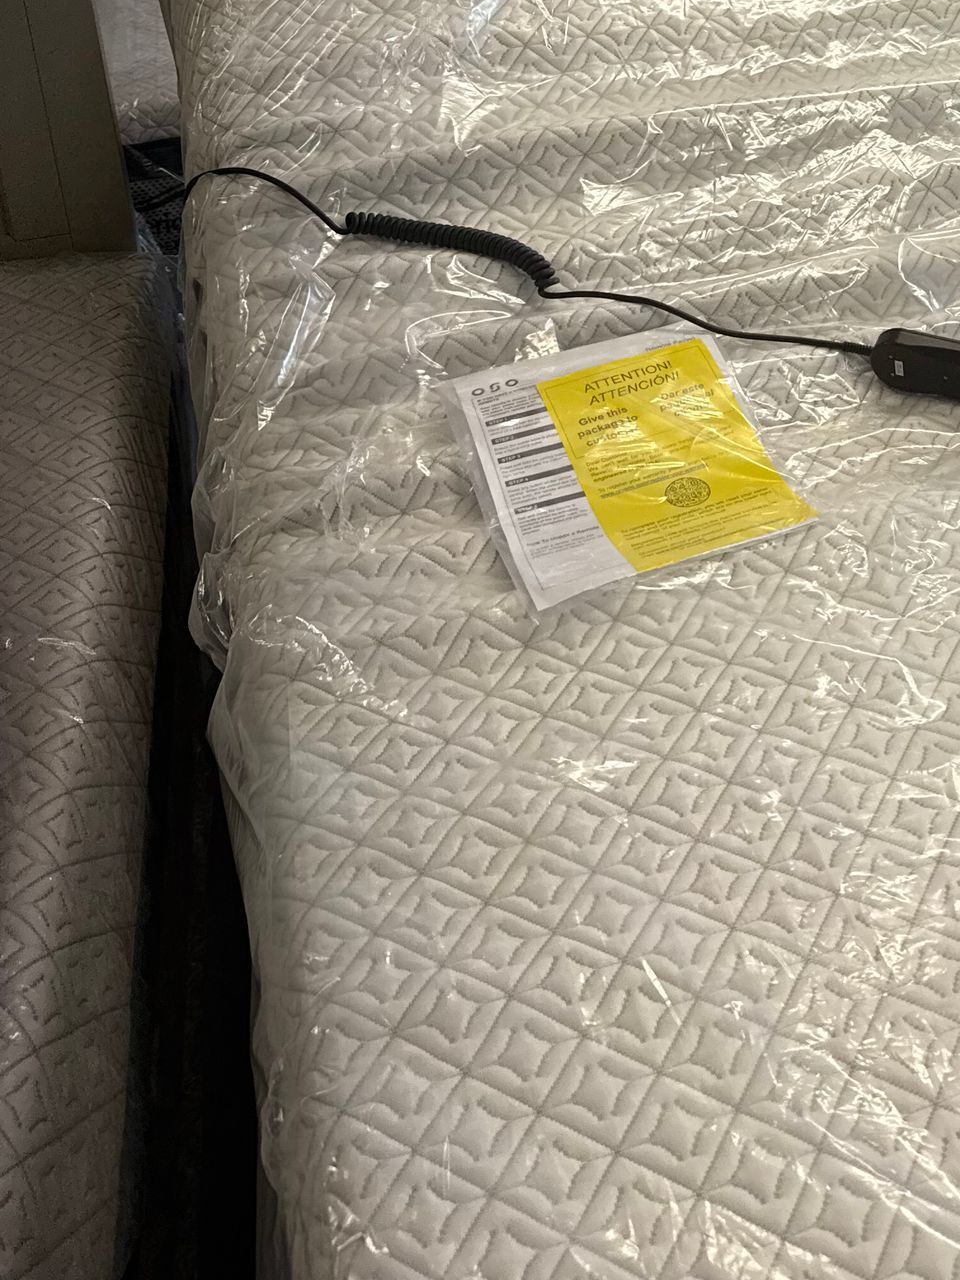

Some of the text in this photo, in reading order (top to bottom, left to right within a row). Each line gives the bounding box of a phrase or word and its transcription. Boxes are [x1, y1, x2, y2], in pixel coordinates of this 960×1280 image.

[584, 360, 673, 393] ATTENTION!
[589, 370, 680, 406] ATTENCIÓN!
[577, 415, 639, 439] package to
[578, 407, 628, 426] Give this
